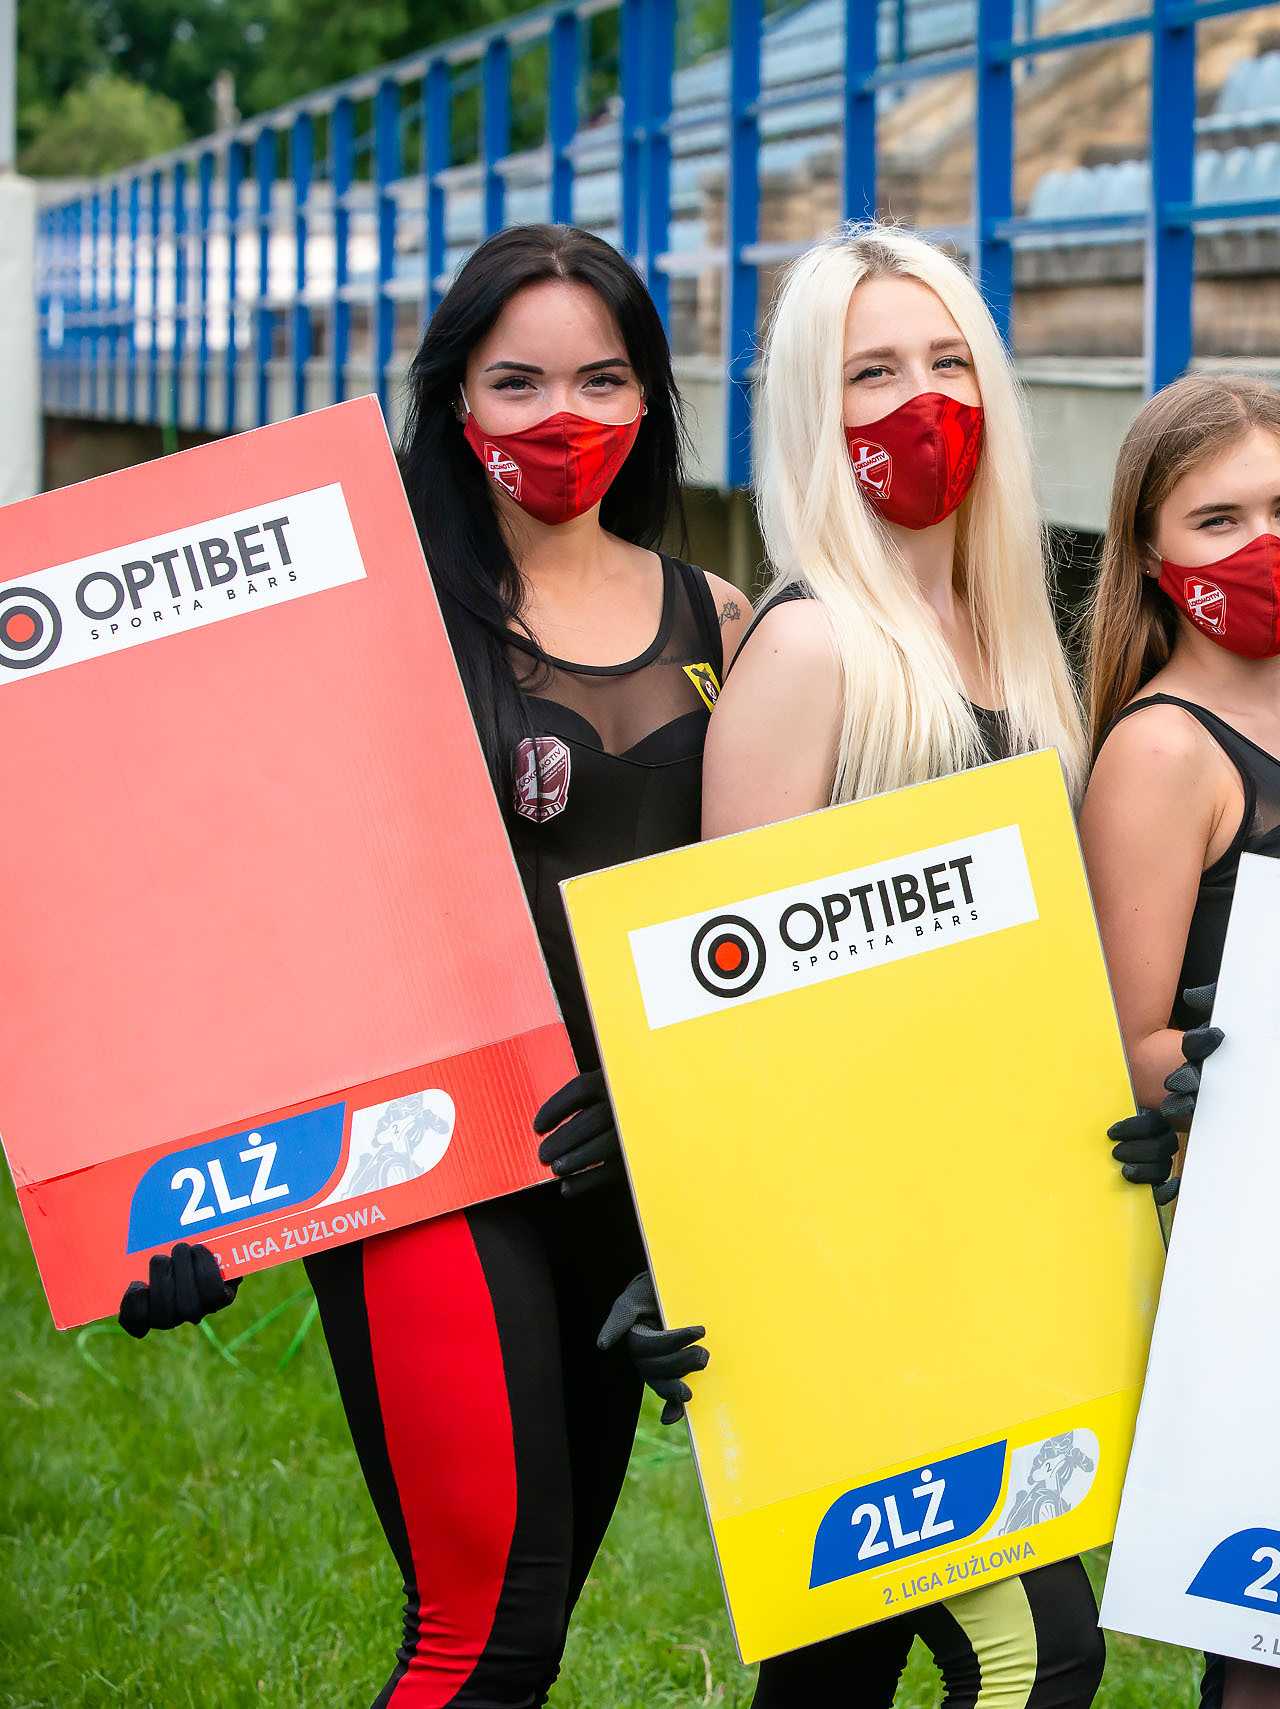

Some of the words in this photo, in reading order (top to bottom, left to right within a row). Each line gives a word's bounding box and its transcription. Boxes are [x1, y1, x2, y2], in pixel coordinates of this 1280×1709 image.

[75, 516, 292, 621] OPTIBET
[90, 599, 203, 641] SPORTA
[226, 570, 298, 600] BĀRS
[778, 854, 975, 952] OPTIBET
[791, 934, 894, 972] SPORTA
[915, 909, 979, 938] BĀRS
[170, 1131, 290, 1227] 2LŻ
[231, 1236, 281, 1266] LIGA
[280, 1204, 387, 1251] ŻUŻLOWA
[850, 1468, 955, 1562] 2LŻ
[882, 1587, 900, 1606] 2.
[902, 1570, 944, 1600] LIGA
[944, 1540, 1037, 1586] ŻUŻLOWA
[1250, 1633, 1268, 1654] 2.
